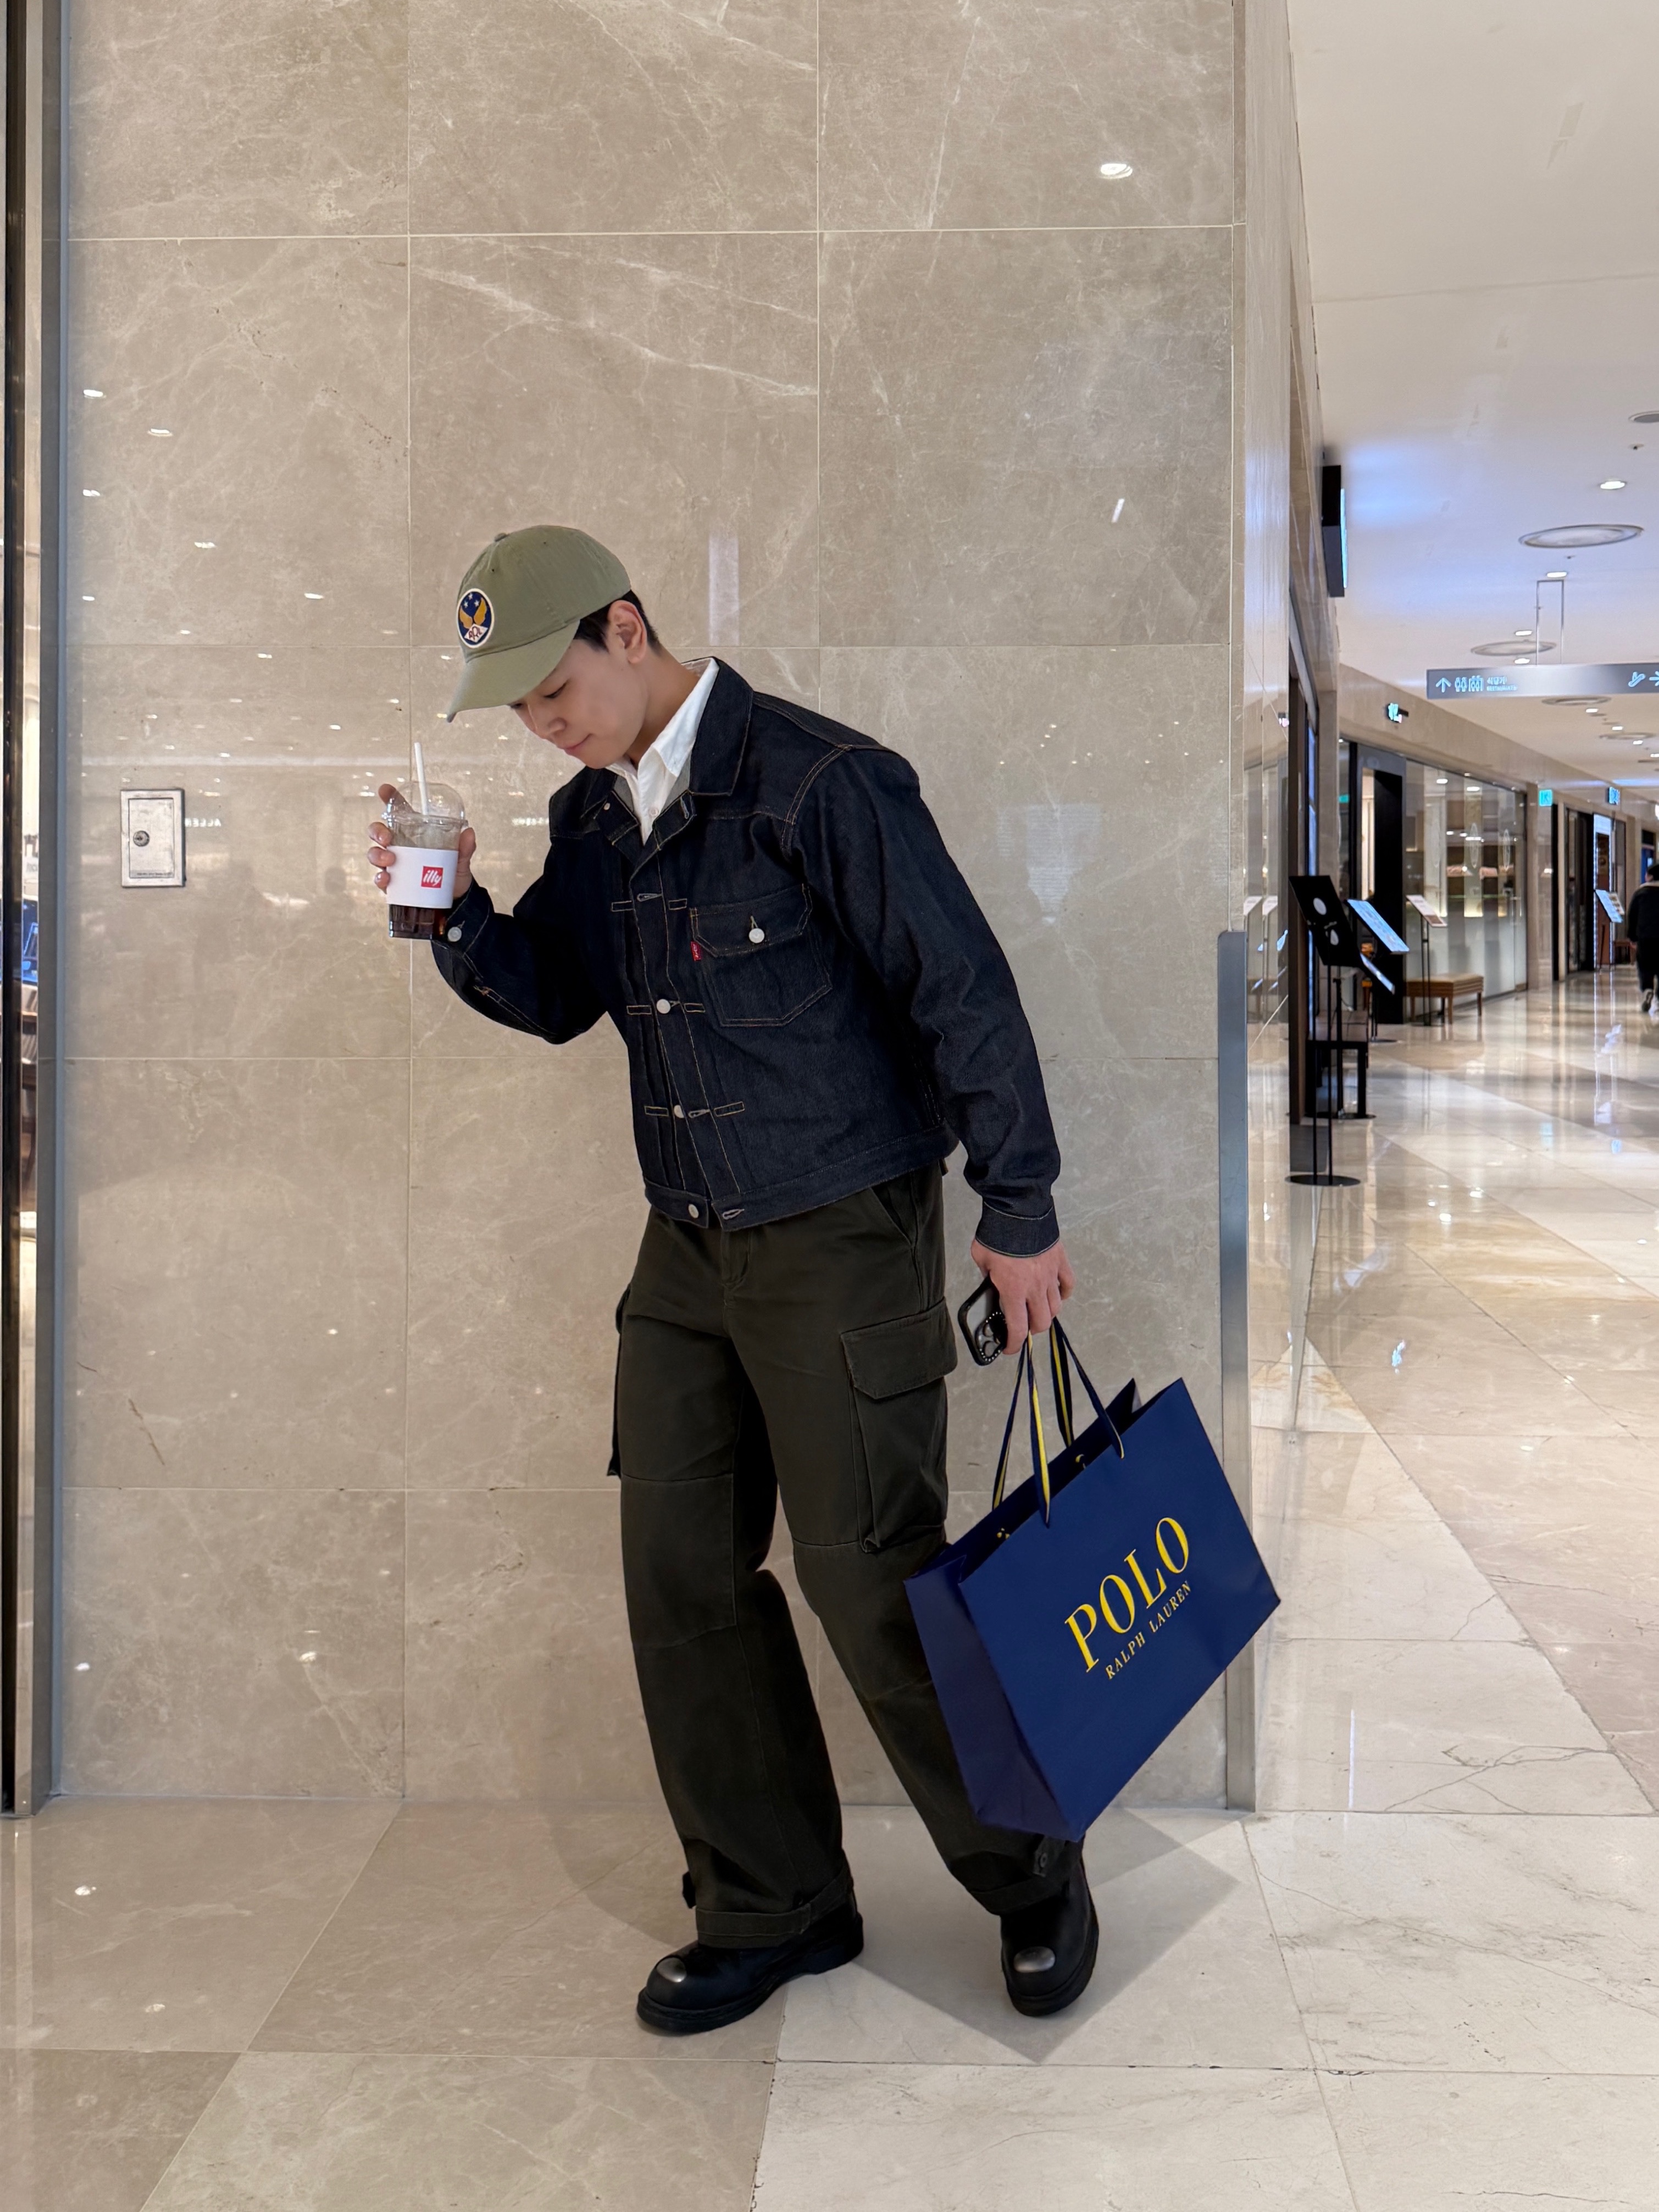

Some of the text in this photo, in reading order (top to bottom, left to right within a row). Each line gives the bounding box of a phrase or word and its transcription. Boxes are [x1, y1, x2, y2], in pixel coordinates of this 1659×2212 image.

[423, 870, 442, 886] illy
[1064, 1517, 1189, 1672] POLO
[1105, 1581, 1191, 1680] RALPH LAUREN
